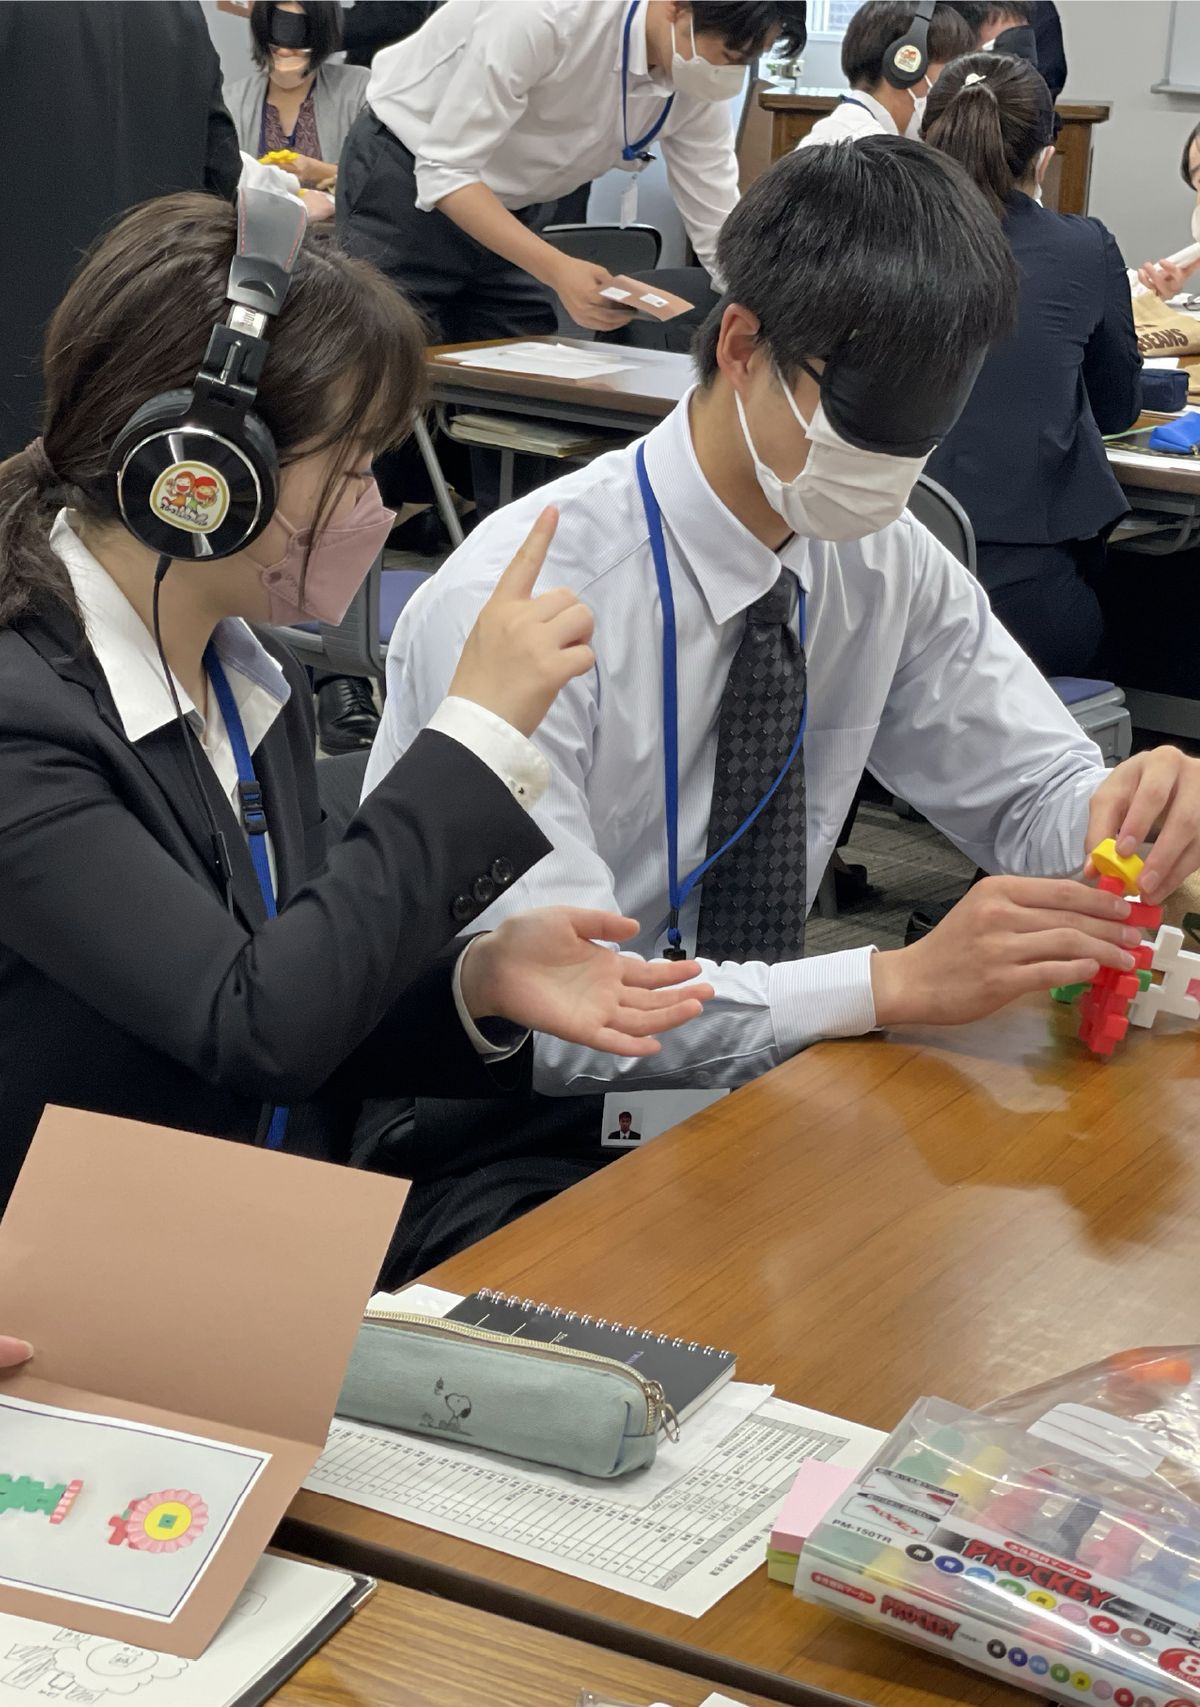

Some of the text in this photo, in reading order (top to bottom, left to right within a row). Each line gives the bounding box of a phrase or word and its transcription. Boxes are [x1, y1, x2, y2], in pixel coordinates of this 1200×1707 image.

[1137, 329, 1189, 352] BEANS
[831, 1519, 893, 1544] PM-150TR
[962, 1538, 1117, 1609] PROCKEY
[880, 1594, 961, 1641] PROCKEY
